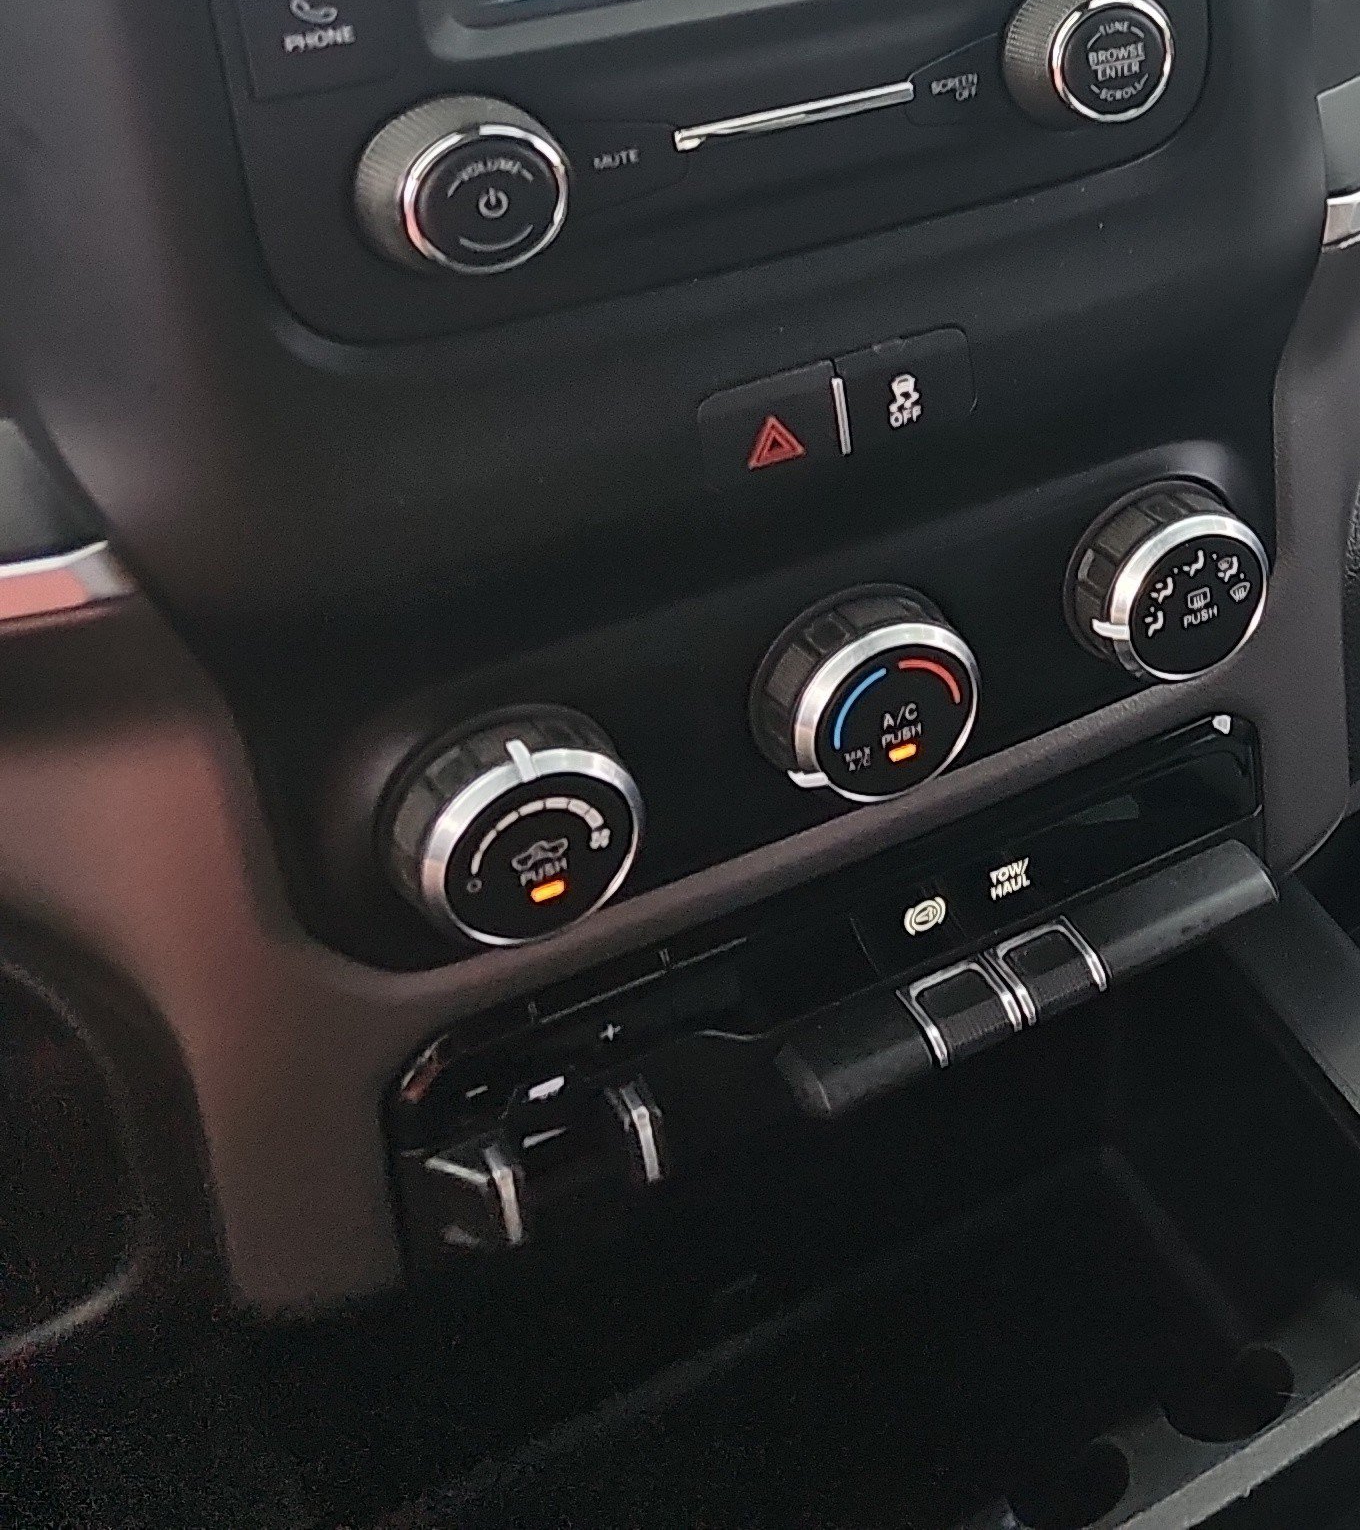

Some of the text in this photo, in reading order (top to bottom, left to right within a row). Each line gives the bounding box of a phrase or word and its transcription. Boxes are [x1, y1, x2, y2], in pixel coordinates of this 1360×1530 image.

[283, 24, 356, 53] PHONE
[1088, 41, 1145, 65] BROWSE
[1098, 61, 1141, 82] ENTER
[931, 73, 978, 96] SCREEN
[1100, 81, 1146, 102] SCROLL
[593, 148, 640, 170] MUTE
[889, 404, 921, 428] OFF
[1183, 605, 1218, 628] PUSH
[883, 702, 918, 731] A/C
[881, 721, 922, 749] PUSH
[519, 856, 568, 887] PUSH
[989, 872, 1031, 901] HAUL
